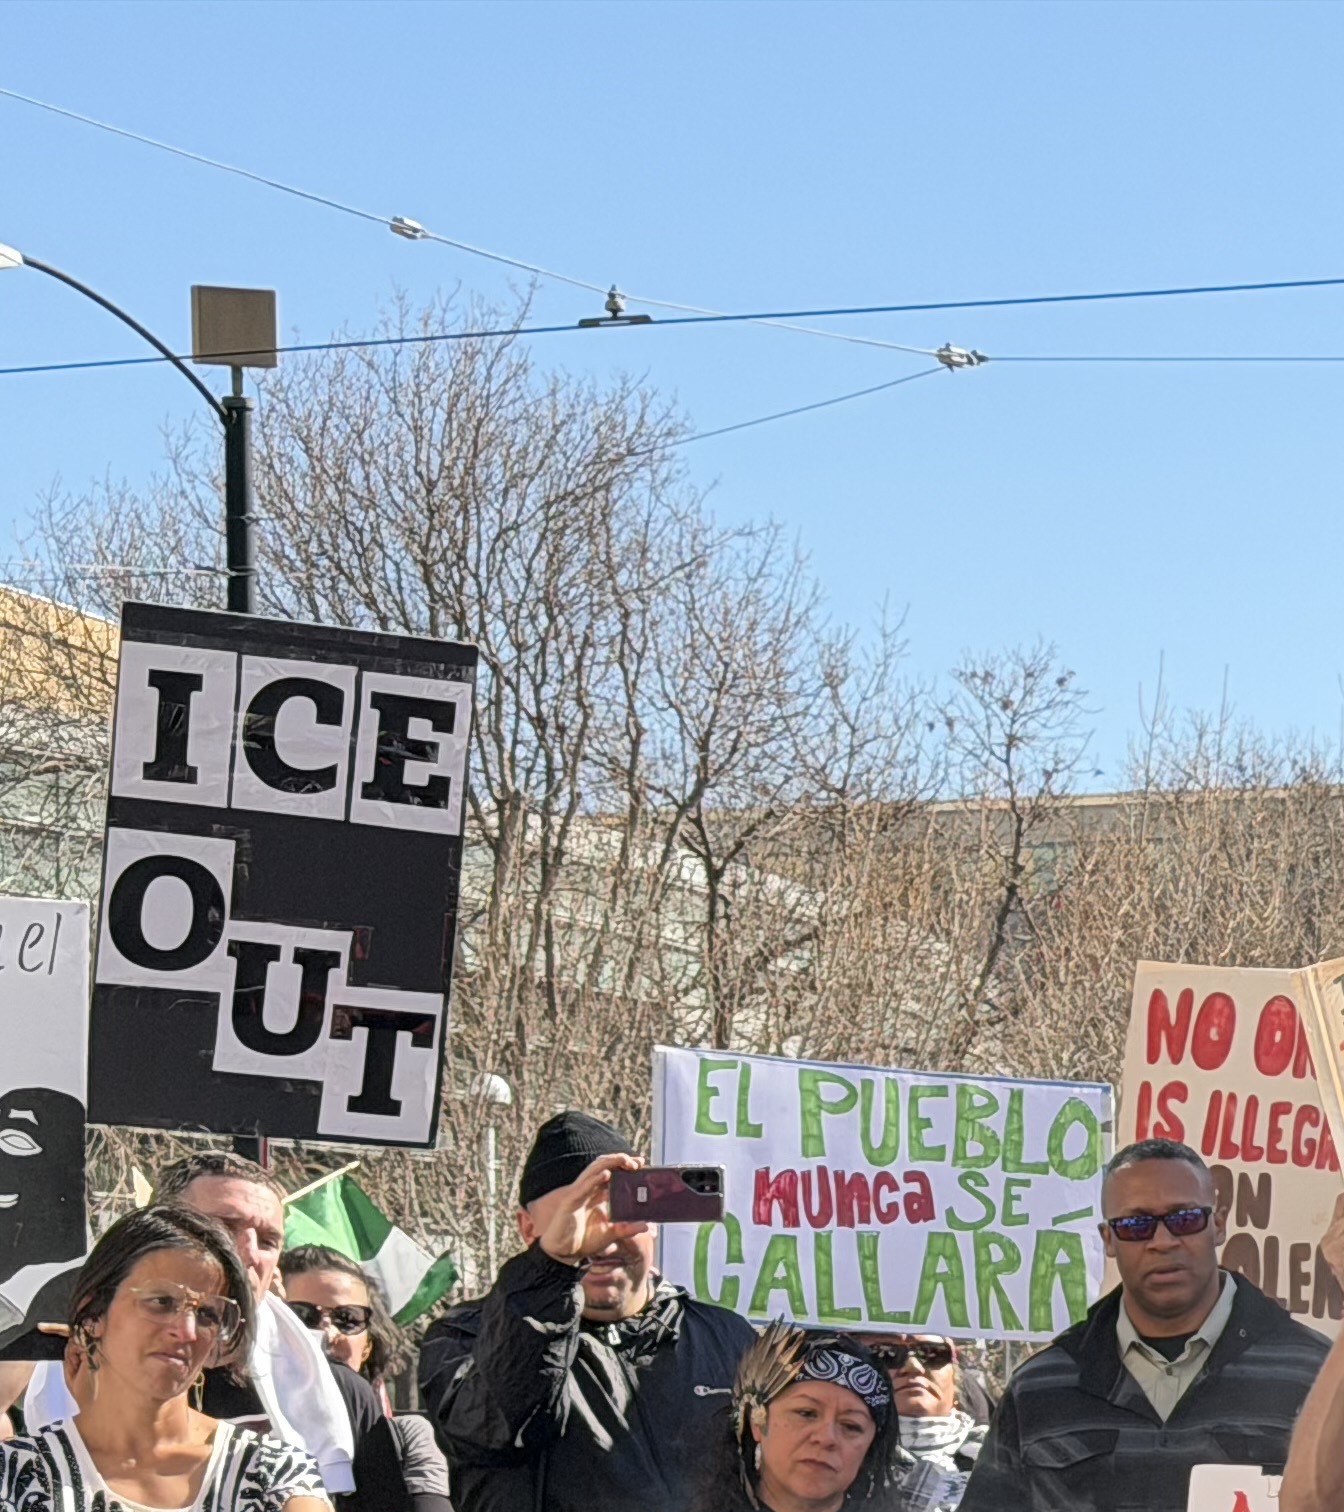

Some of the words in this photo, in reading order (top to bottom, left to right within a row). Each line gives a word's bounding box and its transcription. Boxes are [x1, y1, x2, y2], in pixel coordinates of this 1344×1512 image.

[142, 667, 456, 808] ICE
[108, 854, 436, 1117] OUT
[1146, 988, 1235, 1071] NO
[694, 1058, 763, 1139] EL
[800, 1069, 1103, 1180] PUEBLO
[1136, 1080, 1188, 1142] IS
[1201, 1090, 1340, 1172] ILLEGA
[945, 1171, 1032, 1231] SE
[693, 1205, 1094, 1333] CALLARÁ
